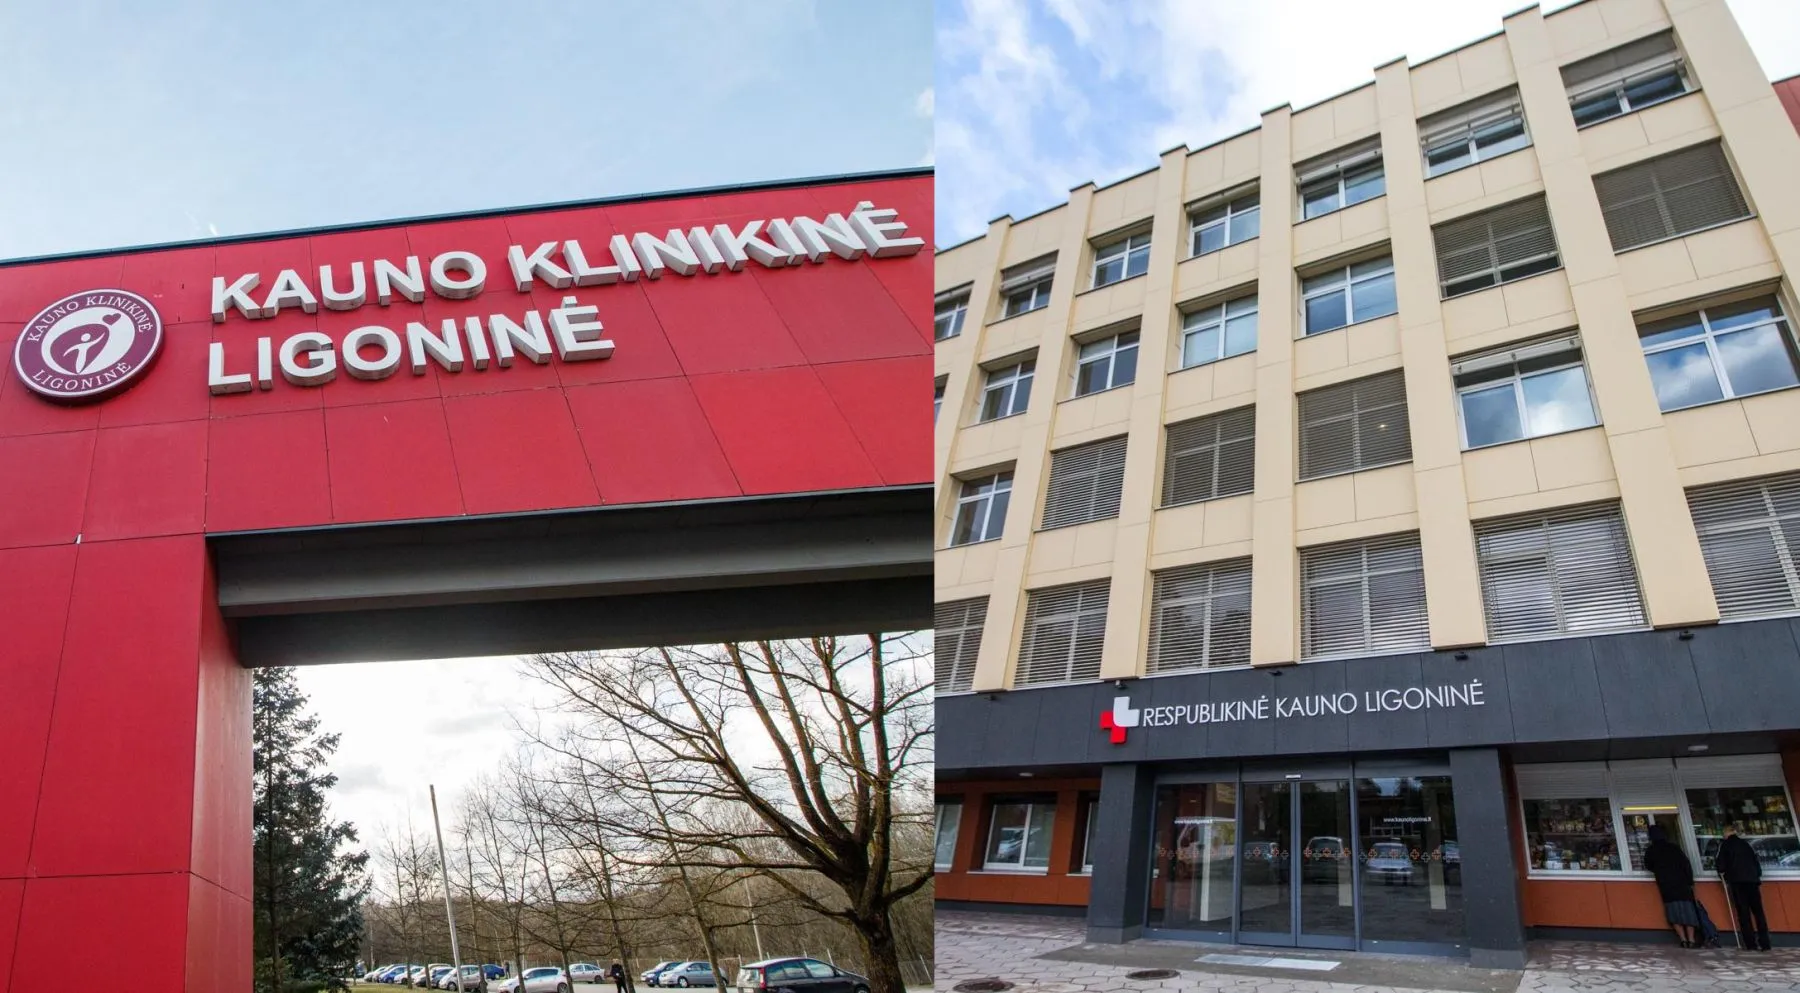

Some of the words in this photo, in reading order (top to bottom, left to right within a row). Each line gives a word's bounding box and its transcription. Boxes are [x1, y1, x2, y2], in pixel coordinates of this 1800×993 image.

[211, 250, 488, 323] KAUNO
[507, 200, 926, 293] KLINIKINĖ
[26, 300, 79, 343] KAUNO
[86, 295, 154, 333] KLINIKINĖ
[208, 295, 616, 395] LIGONINĖ
[32, 362, 133, 391] LIGONINĖ
[1142, 695, 1270, 728] RESPUBLIKINĖ
[1275, 692, 1359, 718] KAUNO
[1364, 678, 1485, 713] LIGONINĖ
